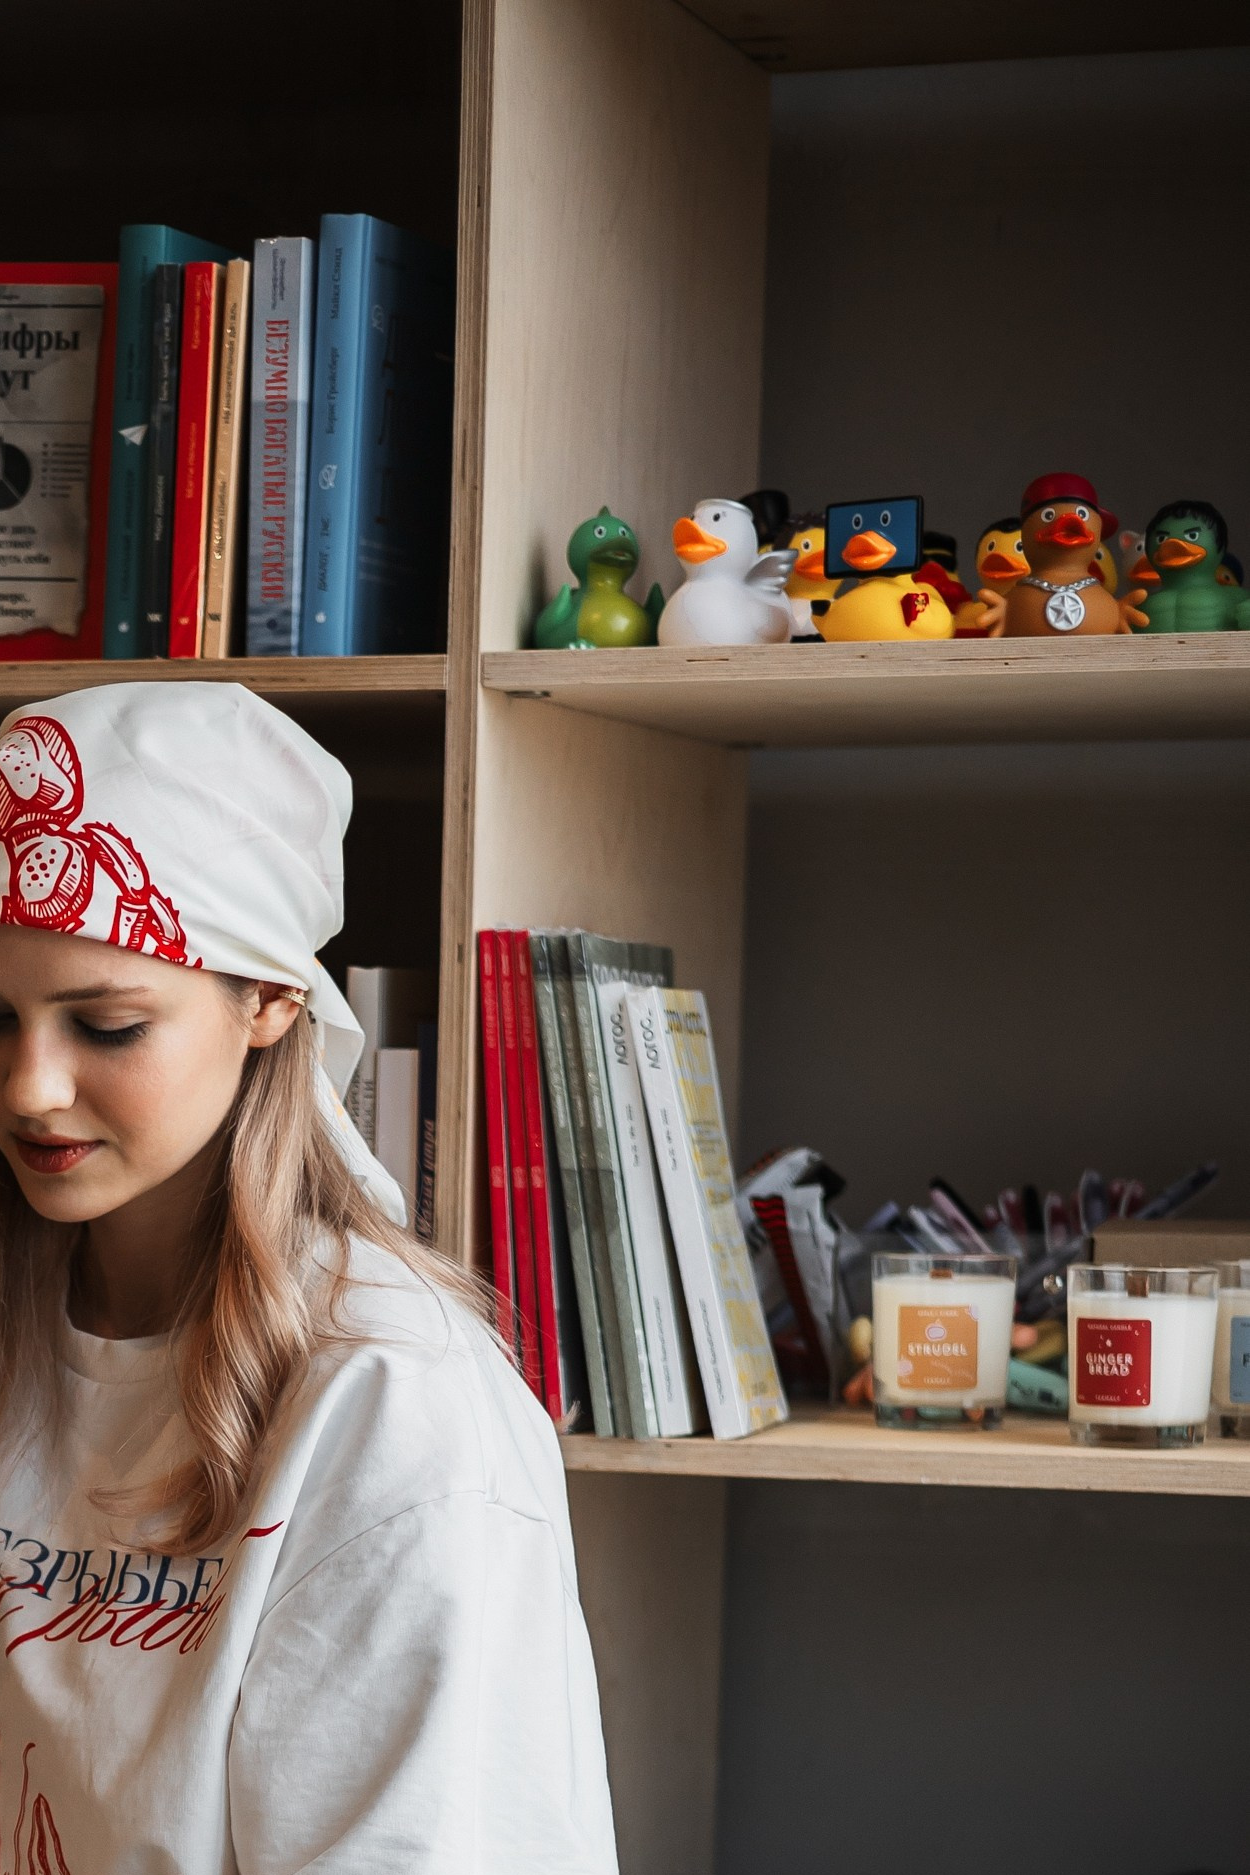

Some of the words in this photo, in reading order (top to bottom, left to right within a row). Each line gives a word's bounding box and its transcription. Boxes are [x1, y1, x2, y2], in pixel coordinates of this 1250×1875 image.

[263, 319, 290, 413] БЕЗУМНО
[261, 417, 288, 510] БОГАТЫЕ
[260, 516, 287, 602] РУССКИЕ
[422, 1119, 436, 1172] утра
[908, 1341, 968, 1358] STRUDEL
[1085, 1352, 1134, 1367] GINGER
[1088, 1363, 1130, 1377] BREAD
